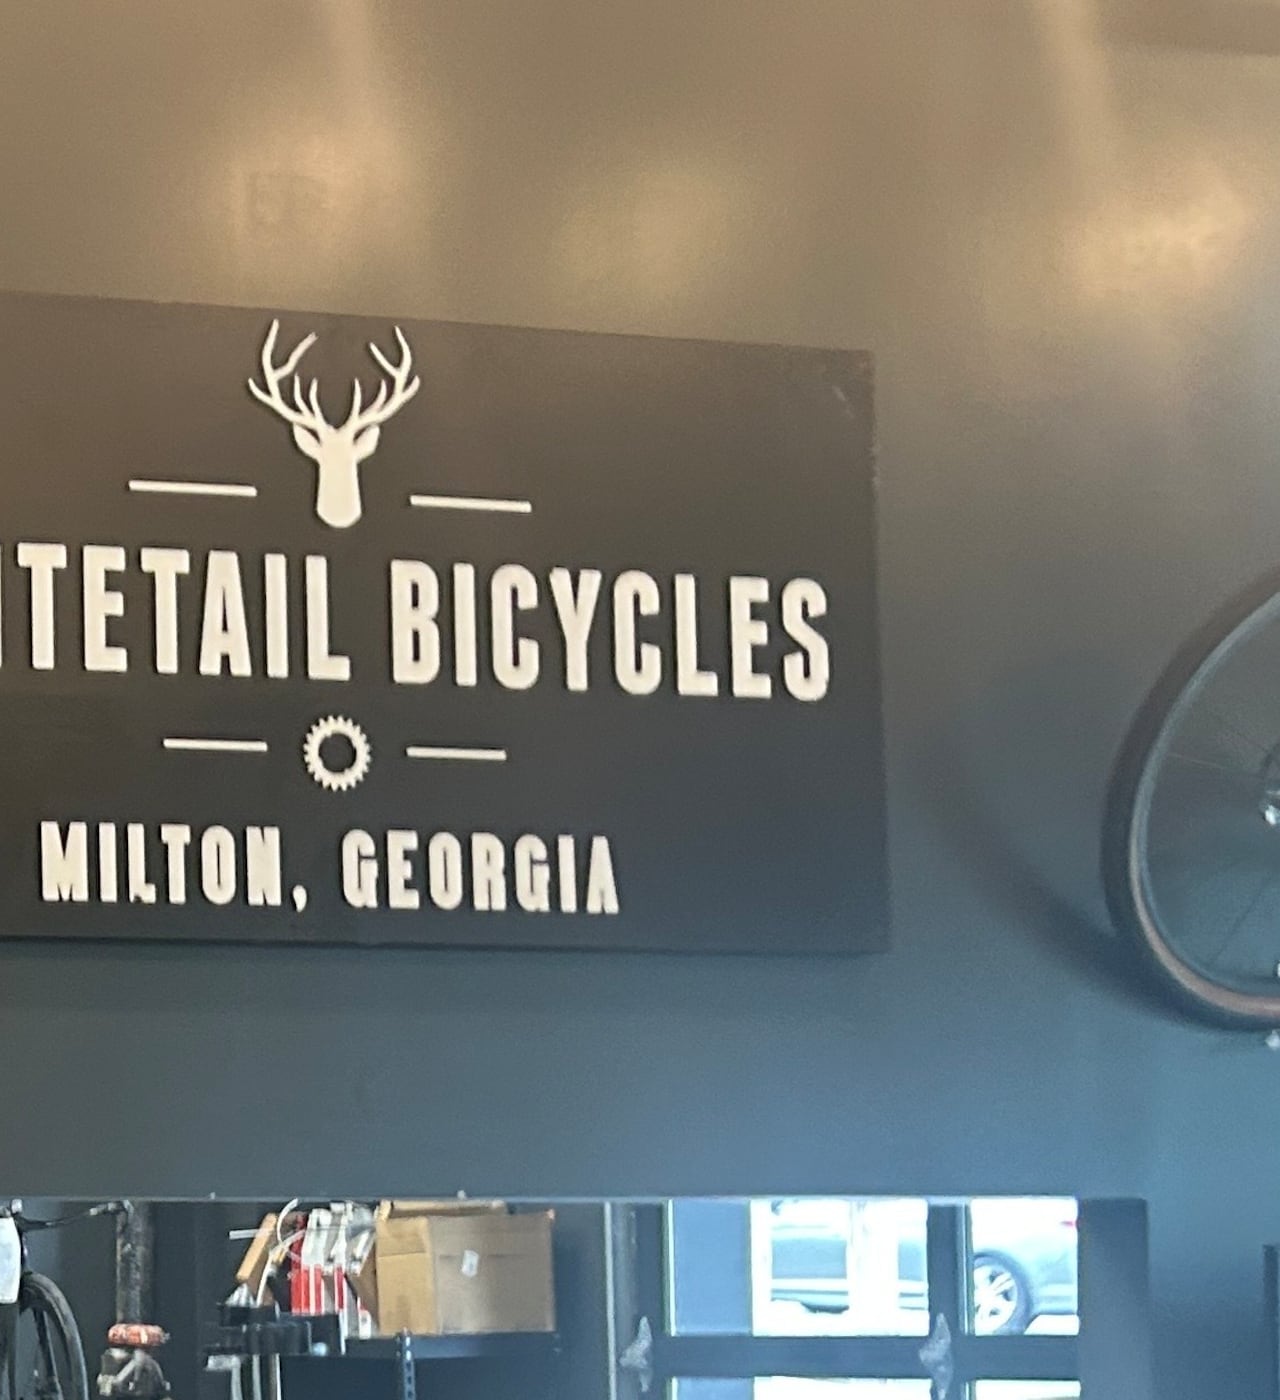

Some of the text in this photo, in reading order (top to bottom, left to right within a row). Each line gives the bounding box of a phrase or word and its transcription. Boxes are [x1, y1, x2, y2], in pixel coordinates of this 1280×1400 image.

[390, 558, 832, 702] BICYCLES
[39, 820, 620, 916] MILTON, GEORGIA
